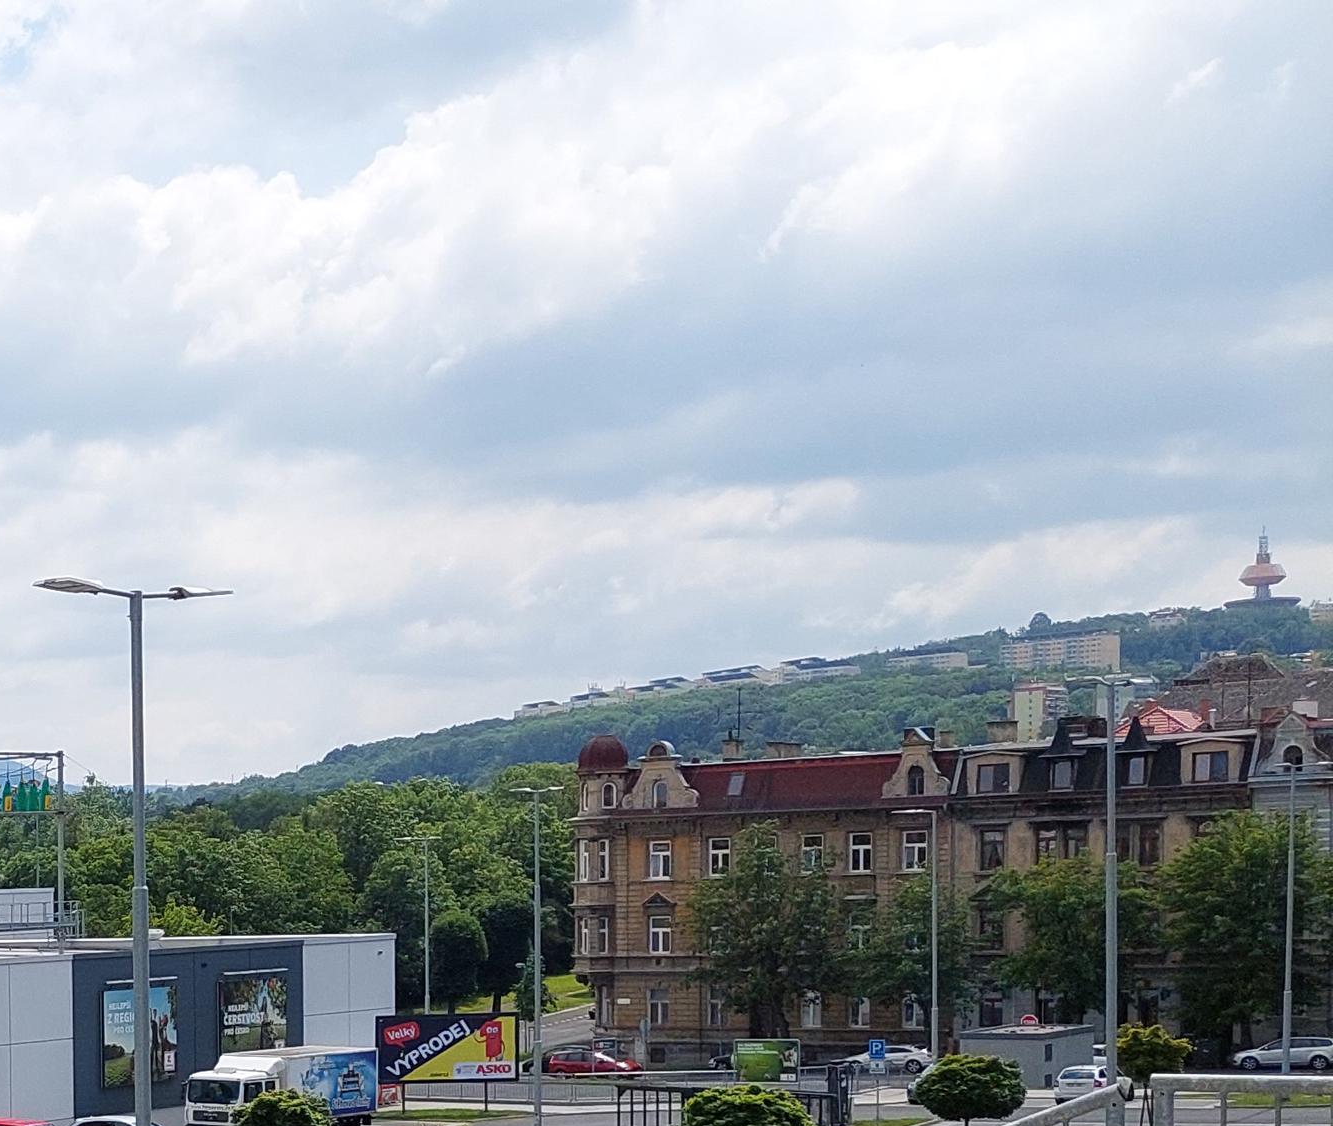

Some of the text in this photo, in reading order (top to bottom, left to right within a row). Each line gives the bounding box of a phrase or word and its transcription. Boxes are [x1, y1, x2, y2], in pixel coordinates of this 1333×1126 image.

[114, 1011, 135, 1024] REGI
[223, 1012, 265, 1026] ČERSTVOST
[388, 1025, 415, 1040] Velký
[386, 1019, 471, 1076] VÝPRODEJ
[872, 1042, 882, 1054] P
[475, 1064, 512, 1077] ASKO
